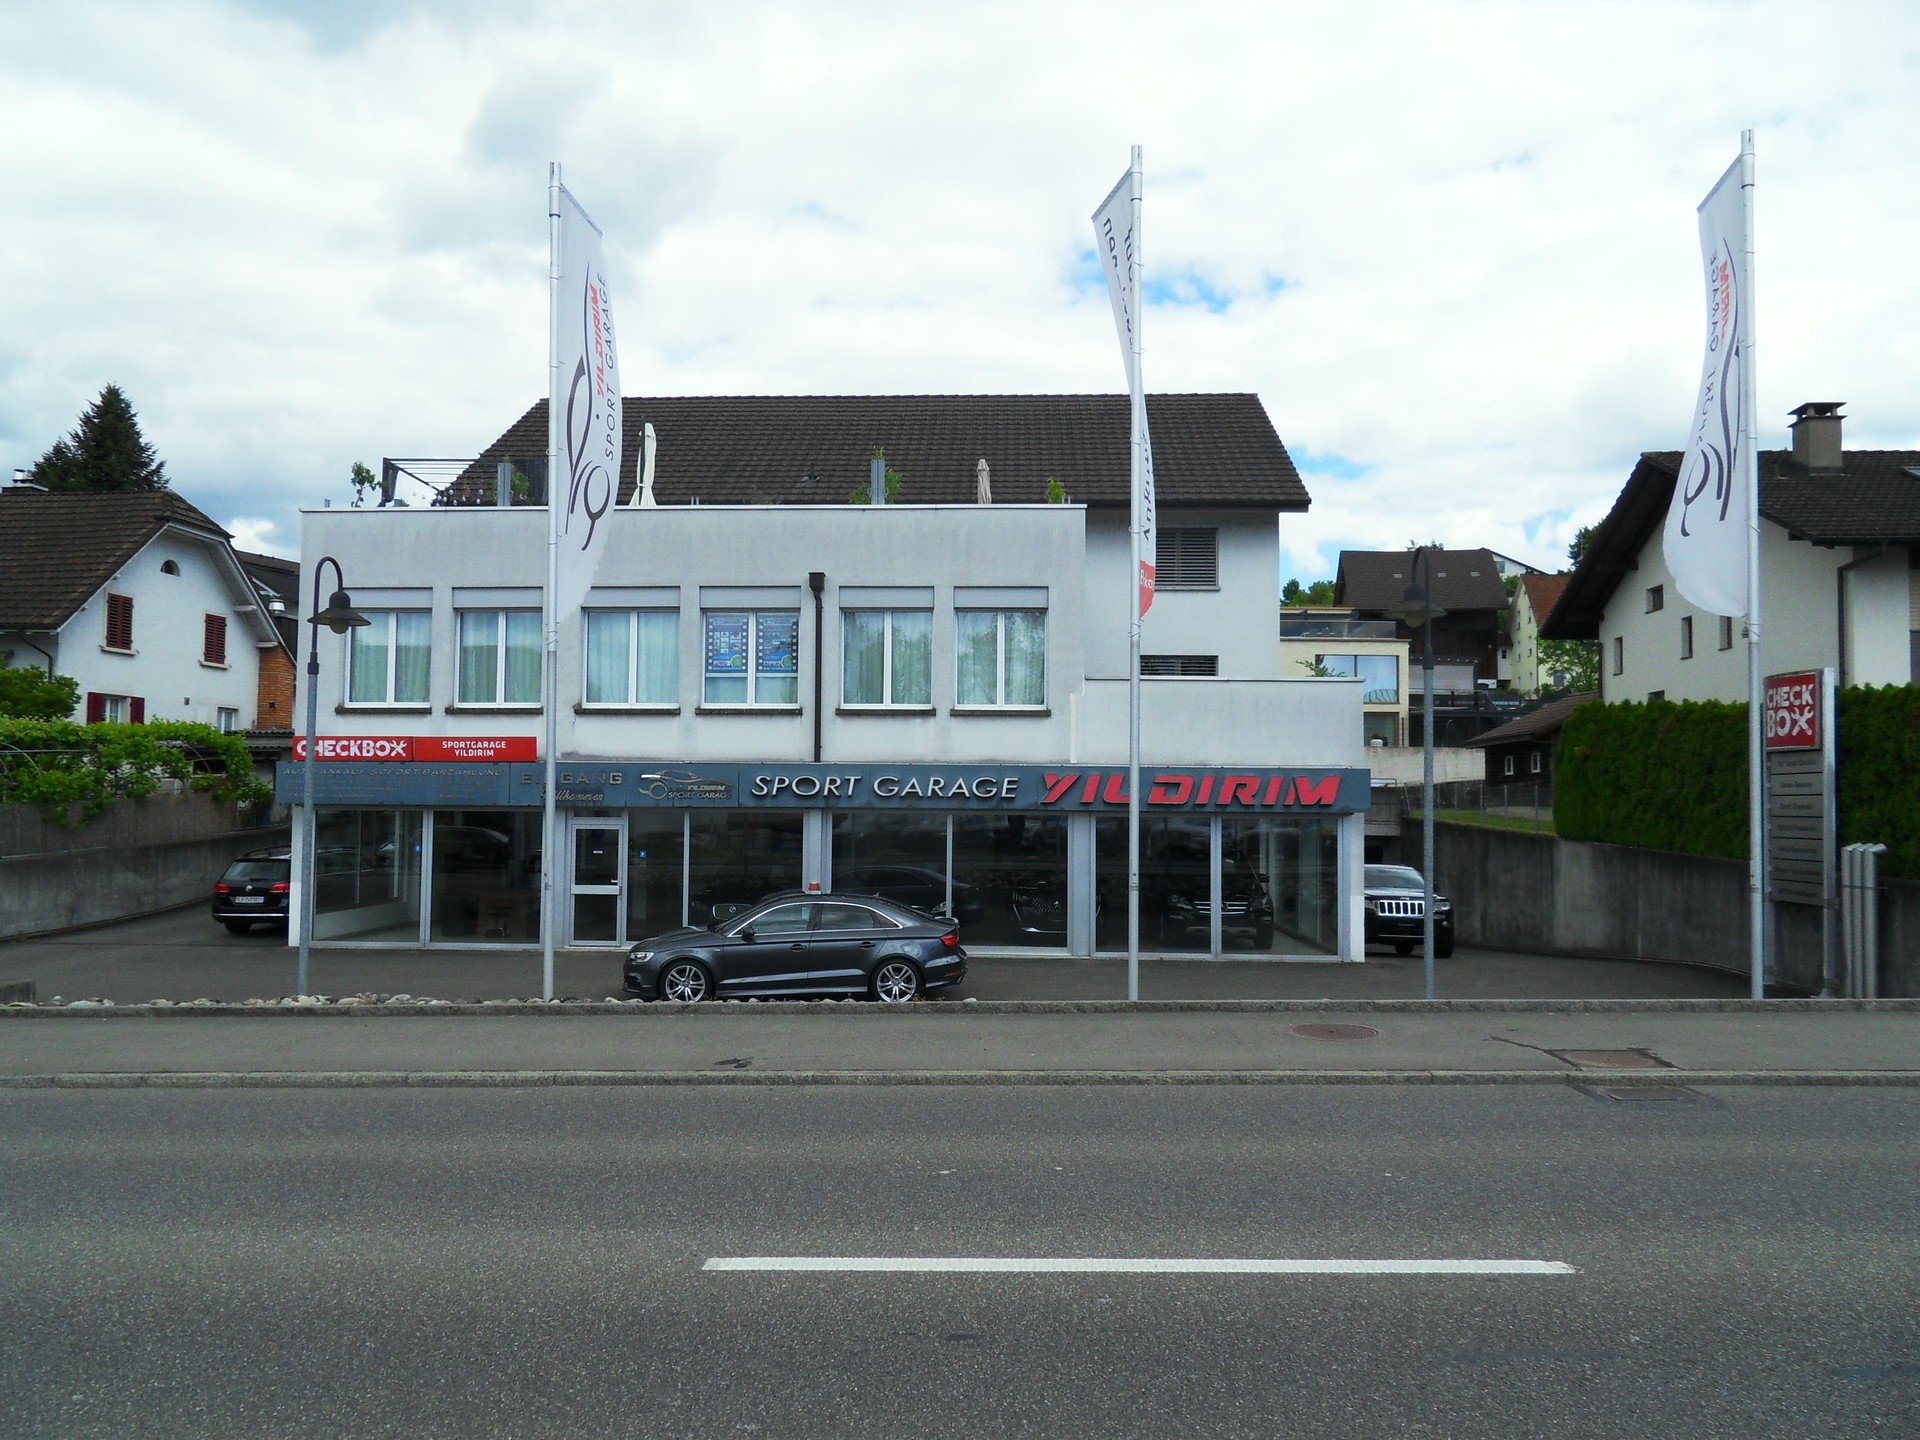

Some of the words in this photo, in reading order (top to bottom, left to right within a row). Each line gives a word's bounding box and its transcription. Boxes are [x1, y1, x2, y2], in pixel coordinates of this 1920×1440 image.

[597, 273, 614, 369] GARAGE
[589, 283, 606, 398] YILDIRIM
[605, 383, 616, 461] SPORT
[1767, 684, 1815, 709] CHECK
[1767, 706, 1814, 737] BOX
[296, 740, 407, 757] CHECKBOX
[442, 741, 507, 749] SPORTGARAGE
[454, 749, 494, 757] YILDIRIM
[422, 768, 503, 776] BARZAHLUNG
[520, 772, 623, 784] EIGANG
[540, 787, 604, 801] llkommen
[751, 775, 861, 797] SPORT
[873, 776, 1018, 798] GARAGE
[1040, 773, 1341, 805] YILDIRIM
